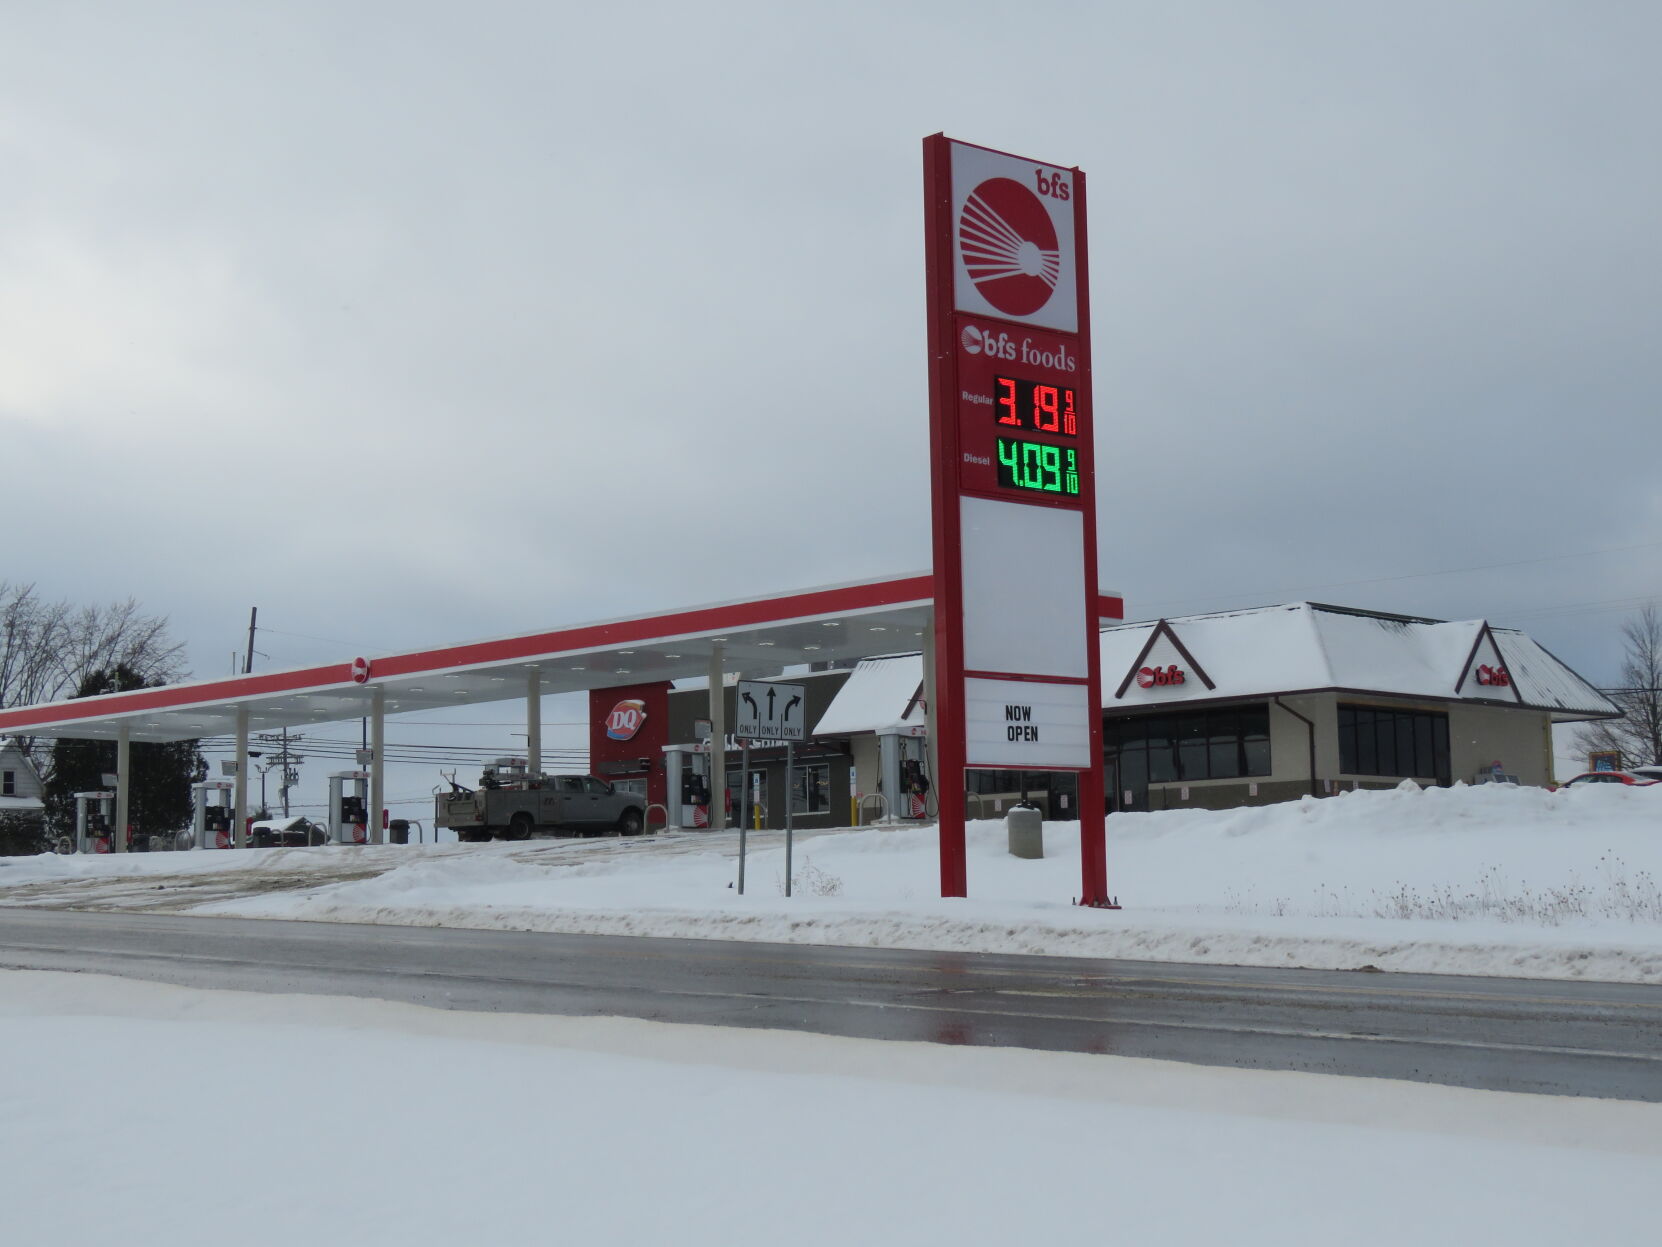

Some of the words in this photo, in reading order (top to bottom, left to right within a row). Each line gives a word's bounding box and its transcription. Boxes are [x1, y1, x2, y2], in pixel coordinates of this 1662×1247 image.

[1035, 168, 1070, 201] bfs
[982, 329, 1016, 361] bfs
[1021, 338, 1076, 372] foods
[962, 390, 994, 406] Regular
[998, 377, 1059, 432] 3.19
[963, 452, 990, 466] Diesel
[998, 438, 1062, 492] 4.09
[1154, 664, 1185, 686] bfs
[611, 709, 637, 730] DQ
[1005, 704, 1031, 722] NOW
[740, 724, 757, 734] ONLY
[761, 726, 779, 735] ONLY
[783, 727, 801, 737] ONLY
[1007, 725, 1038, 742] OPEN
